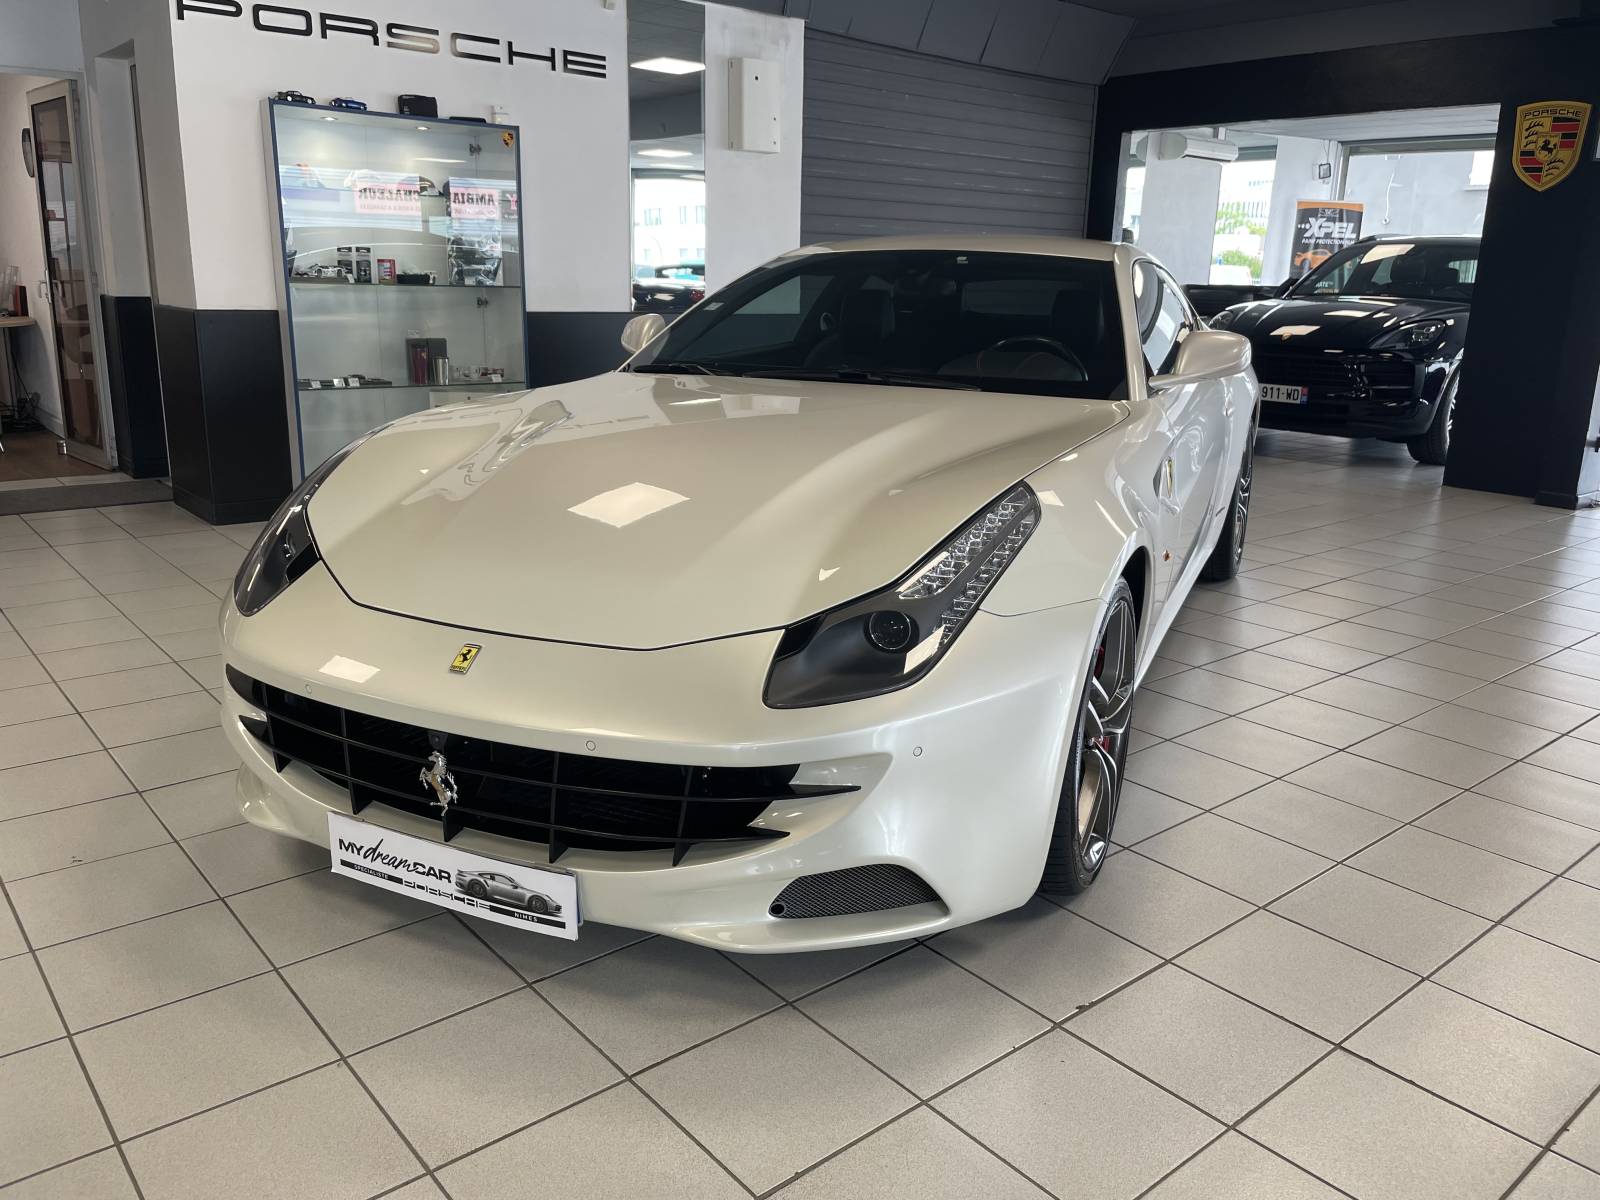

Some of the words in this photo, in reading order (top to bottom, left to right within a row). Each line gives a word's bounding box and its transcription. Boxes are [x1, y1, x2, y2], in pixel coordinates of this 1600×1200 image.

[177, 0, 607, 79] PORSCHE
[1524, 108, 1583, 117] PORSCHE
[1303, 217, 1357, 238] XPEL
[1261, 386, 1300, 401] 911-WD
[402, 878, 490, 910] PORSCHE
